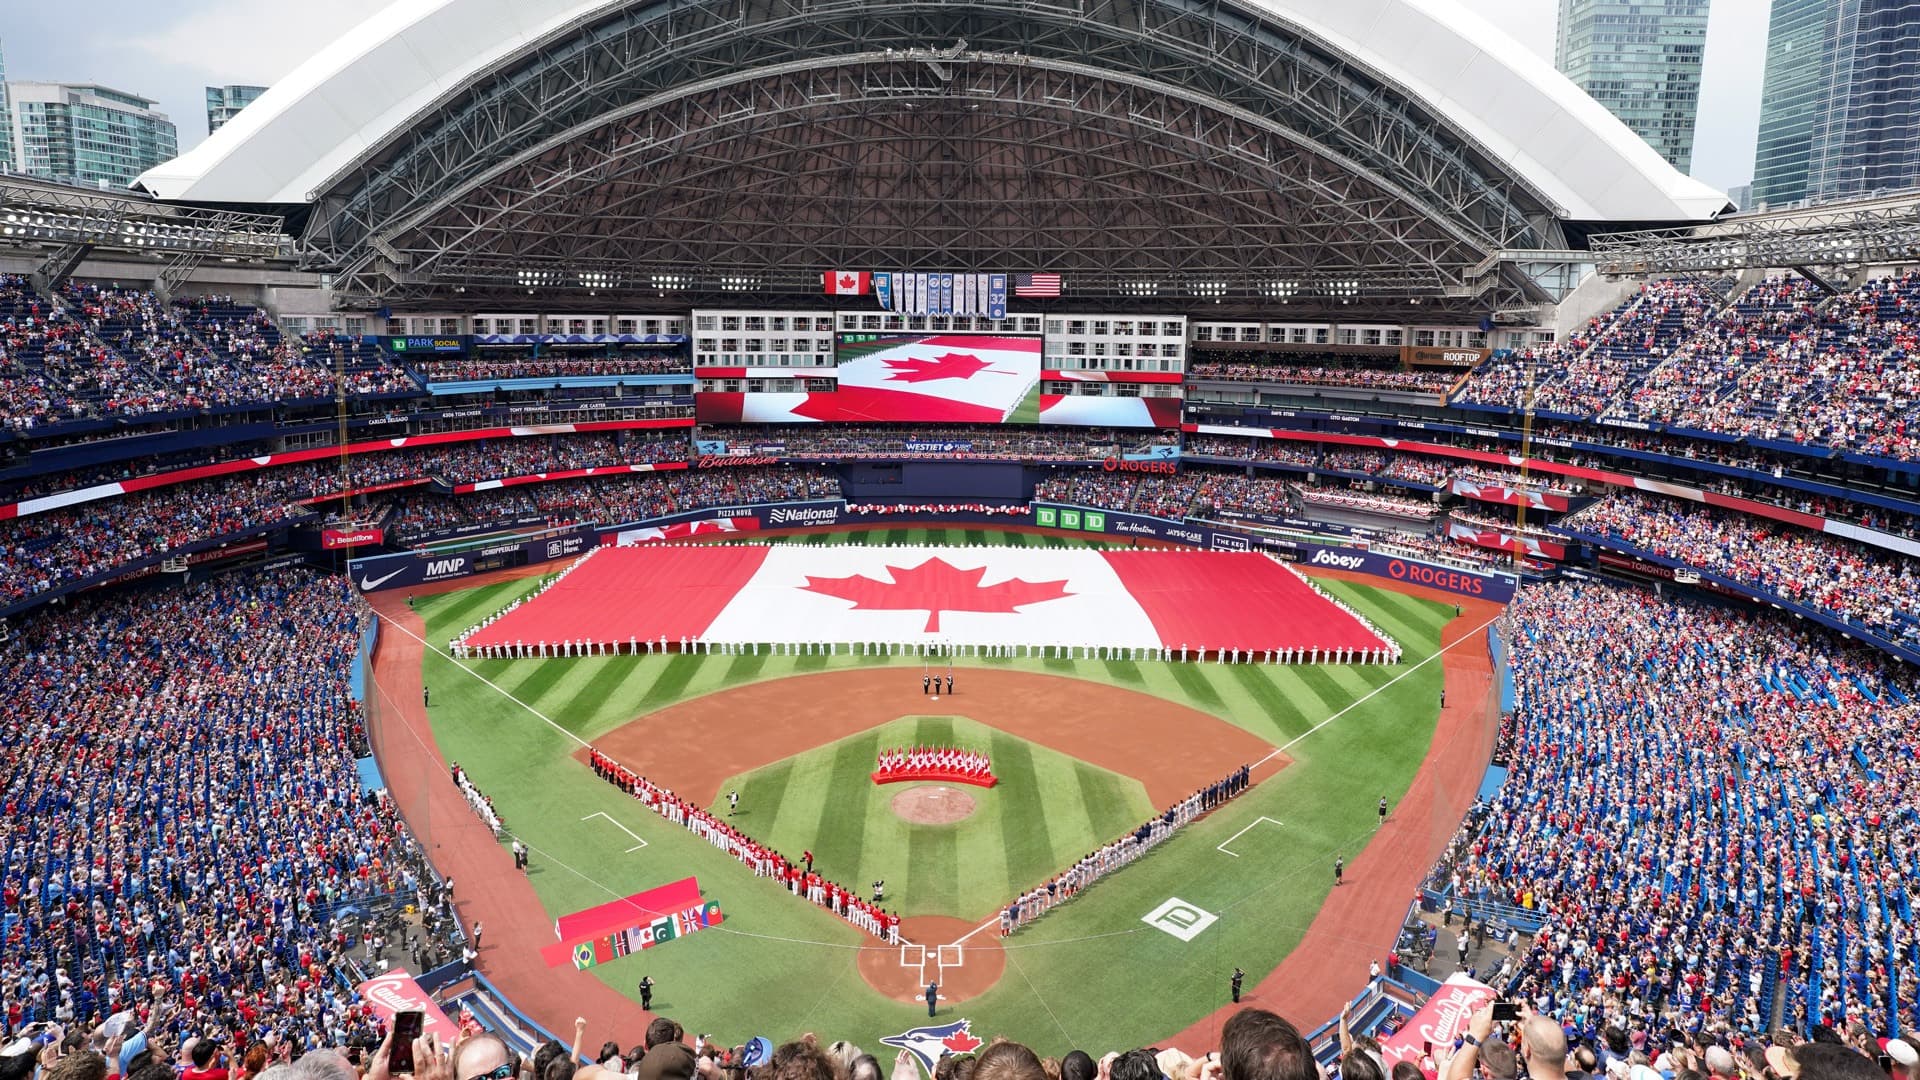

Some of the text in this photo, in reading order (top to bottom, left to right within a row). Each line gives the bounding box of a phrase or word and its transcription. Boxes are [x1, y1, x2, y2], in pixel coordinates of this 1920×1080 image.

[990, 293, 1005, 305] 32
[393, 338, 434, 349] TD PARK
[1443, 352, 1480, 362] ROOFTOP
[388, 416, 409, 424] DELGADO
[1621, 420, 1649, 430] ROBINSON
[906, 443, 943, 451] WESTJET
[698, 455, 780, 468] Budweiser
[1120, 461, 1177, 474] ROGERS
[736, 508, 752, 516] NOVA
[785, 507, 837, 521] National
[1038, 510, 1054, 523] TD
[1062, 513, 1079, 525] TD
[1086, 515, 1103, 528] TD
[1115, 521, 1156, 534] Tim Hortons
[563, 537, 583, 546] Here's
[1166, 529, 1182, 537] JAYS
[1186, 531, 1203, 541] CARE
[1216, 538, 1245, 548] THE KEG
[1312, 549, 1365, 569] Sobeys
[118, 564, 161, 583] TORONTO
[203, 551, 224, 562] JAYS
[426, 557, 465, 577] MNP
[1631, 561, 1671, 577] TORONTO
[1409, 565, 1482, 594] ROGERS
[1154, 905, 1202, 930] TD
[366, 980, 417, 1012] Canada
[1419, 1007, 1461, 1047] Canada
